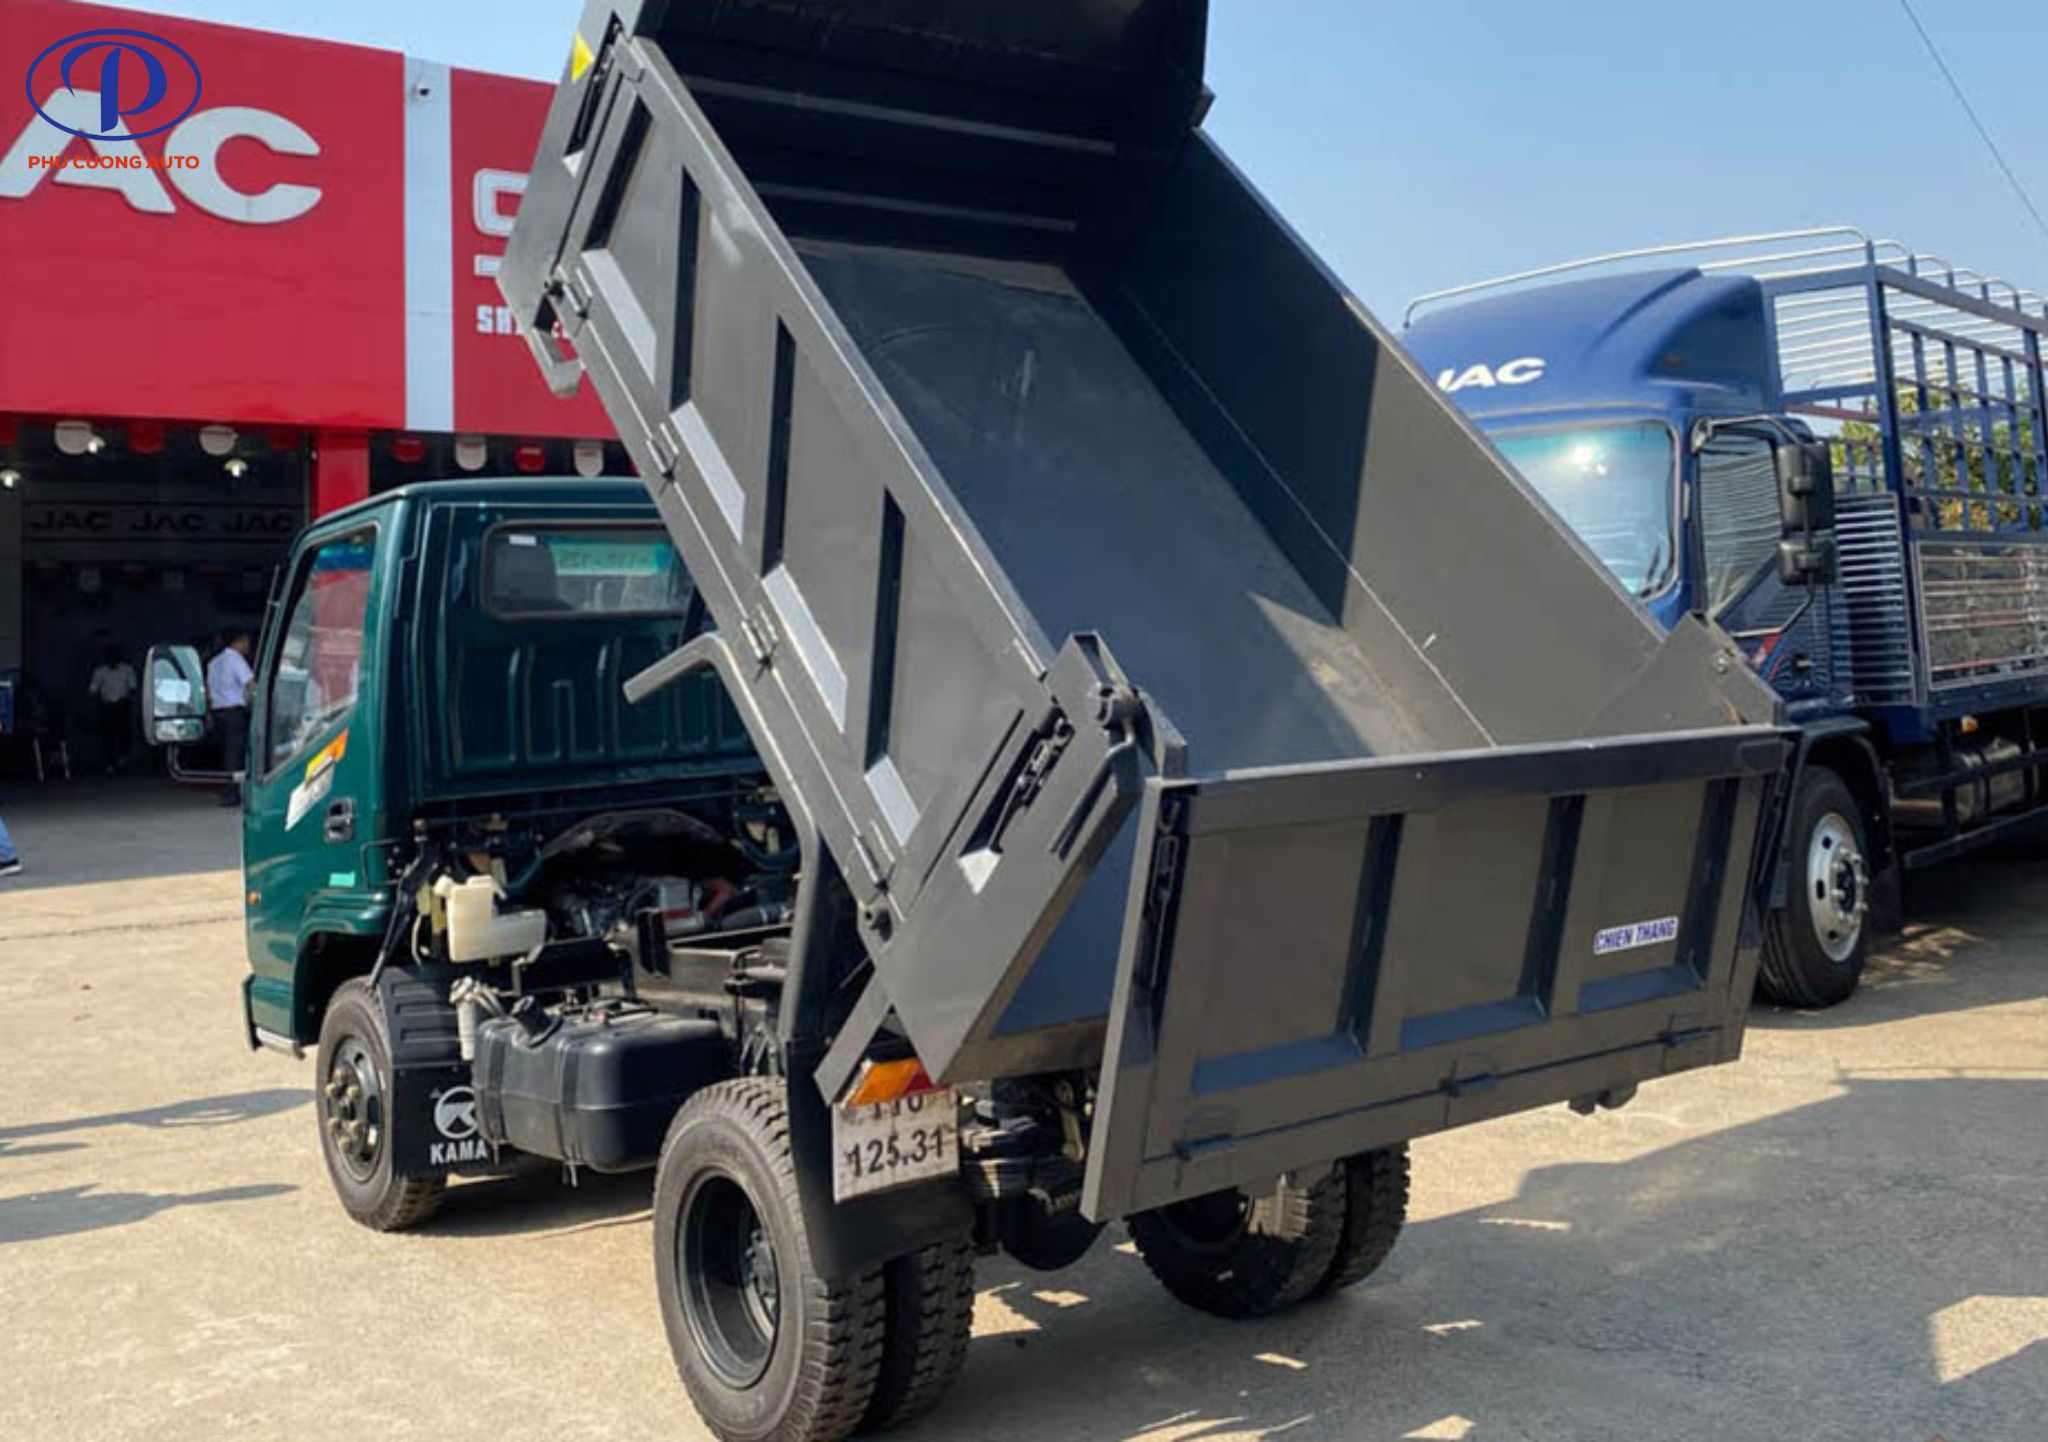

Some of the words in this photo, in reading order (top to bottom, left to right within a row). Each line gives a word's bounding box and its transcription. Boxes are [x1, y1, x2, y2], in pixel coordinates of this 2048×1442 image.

[29, 510, 112, 533] JAC
[130, 510, 206, 533] JAC
[220, 512, 295, 534] JAC
[1595, 927, 1632, 952] CHIEN
[1635, 919, 1677, 942] THANG
[430, 1139, 488, 1166] KAMA
